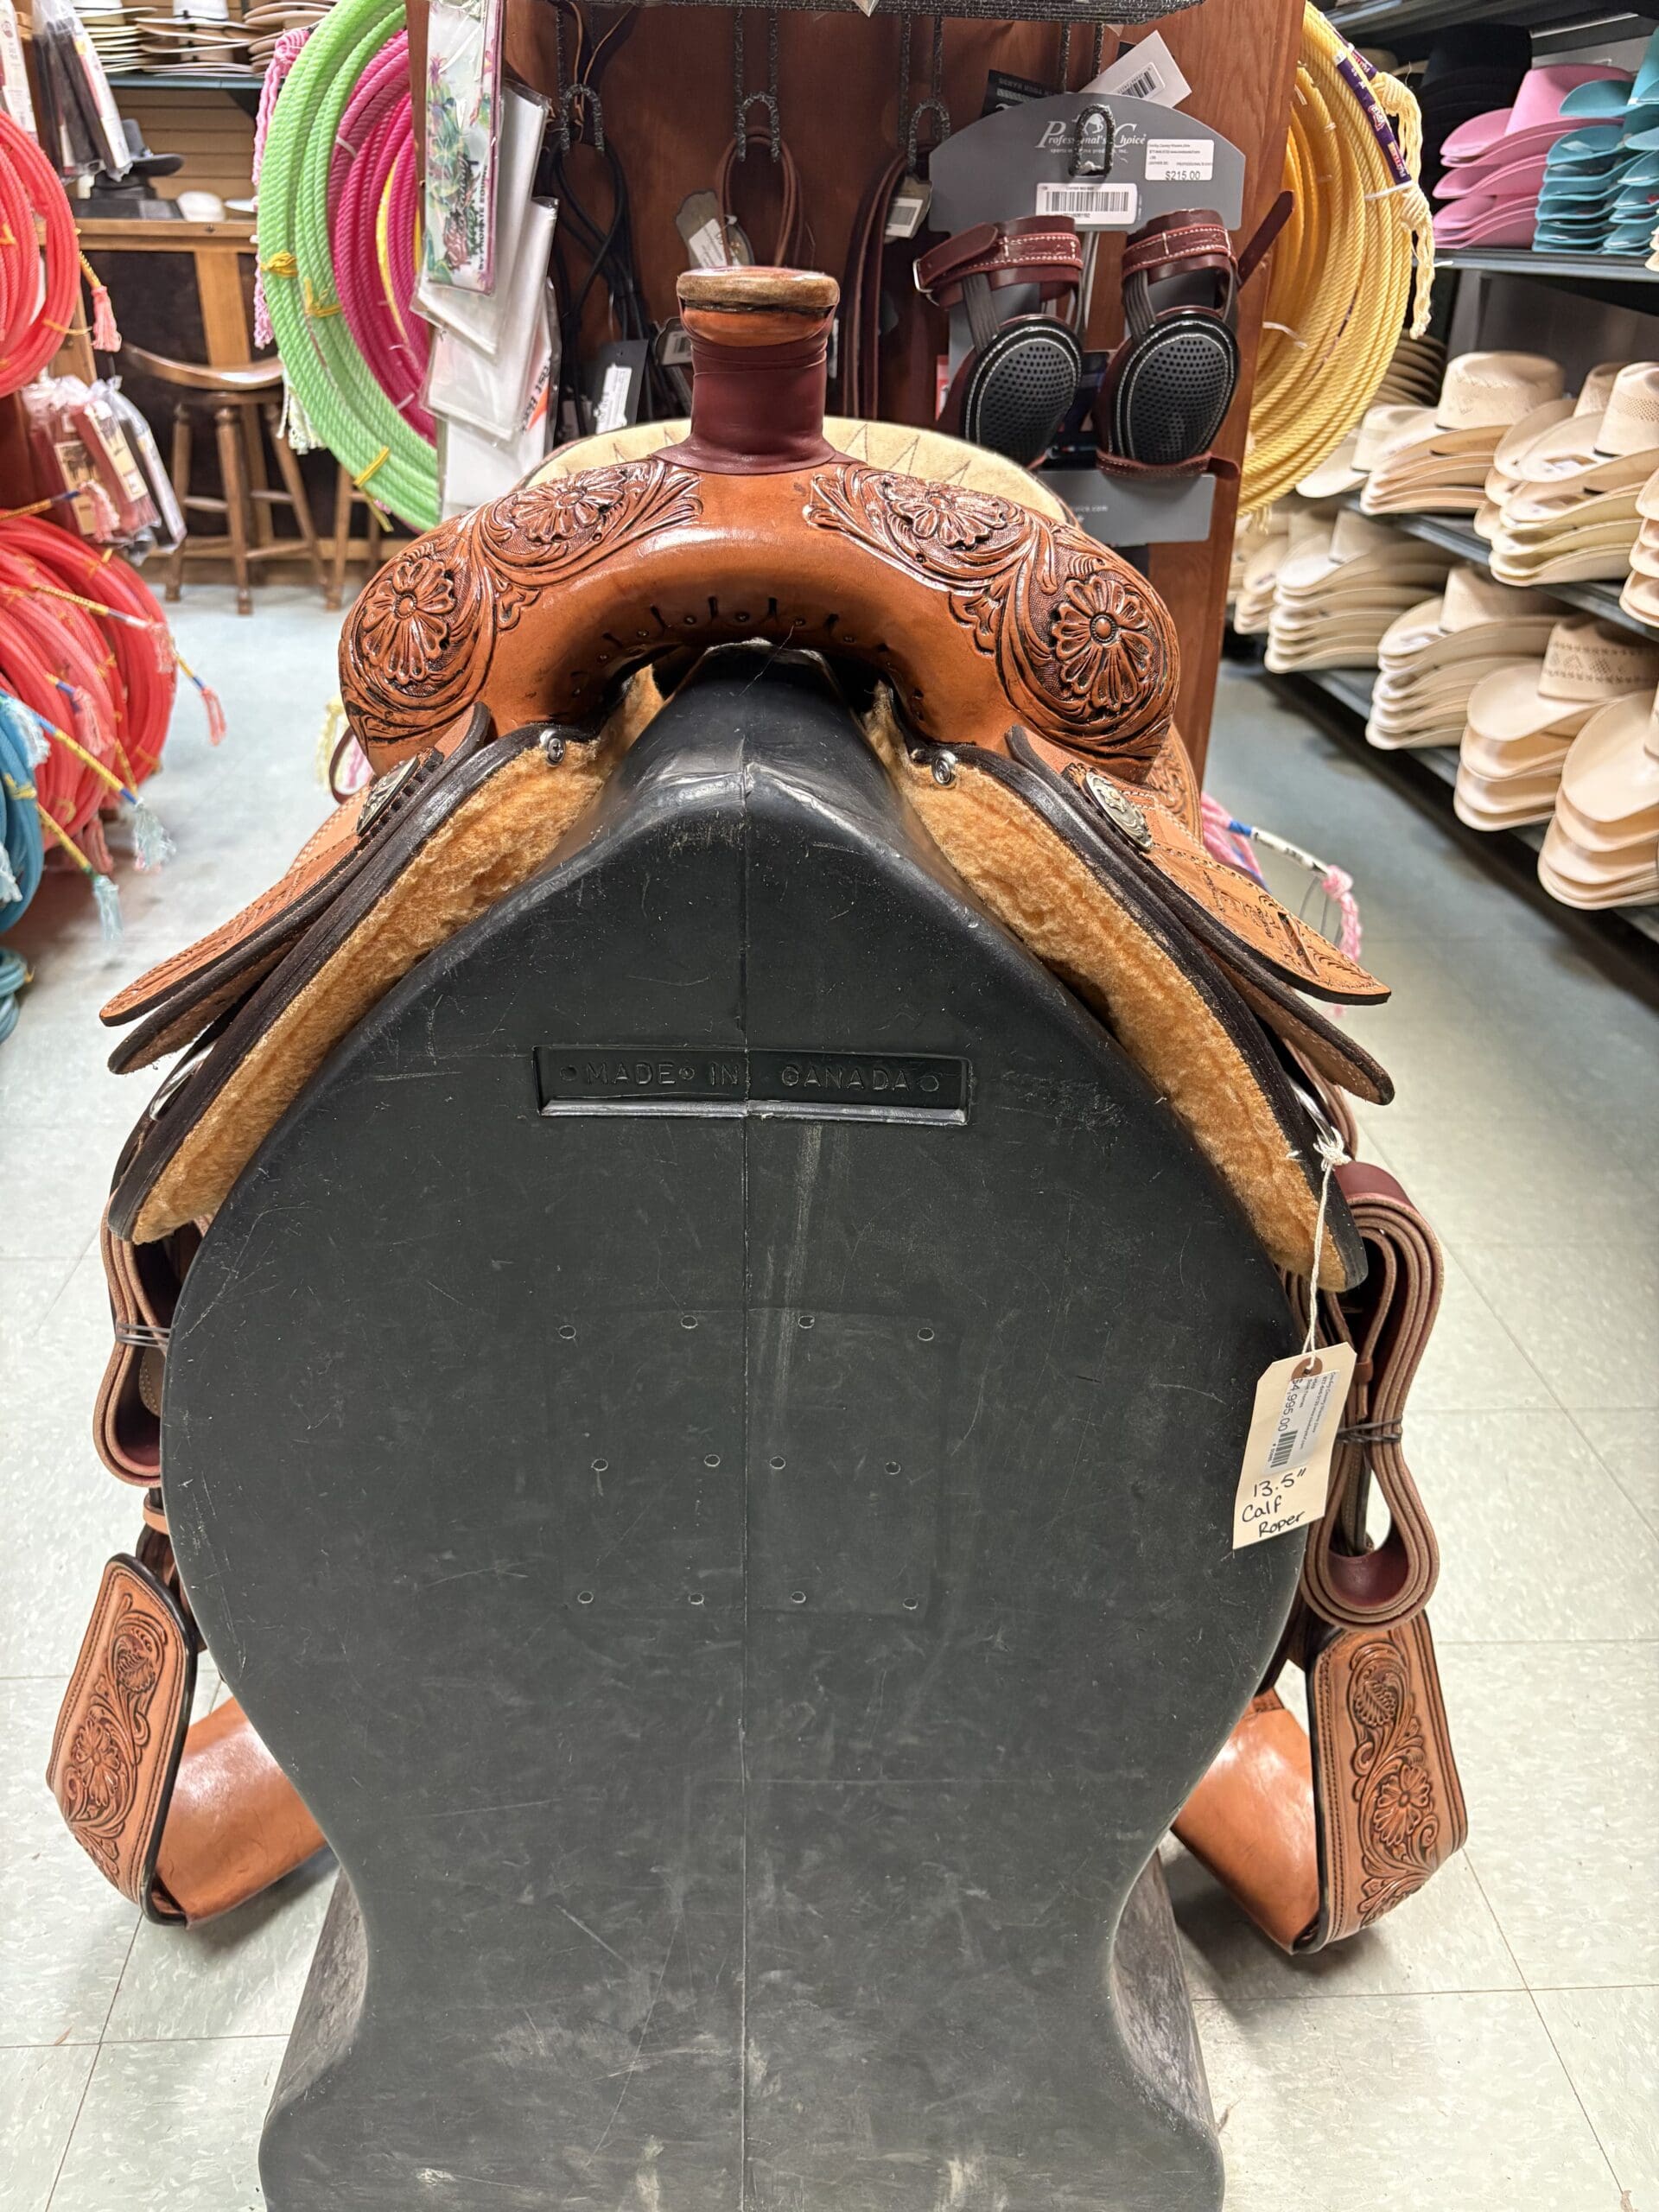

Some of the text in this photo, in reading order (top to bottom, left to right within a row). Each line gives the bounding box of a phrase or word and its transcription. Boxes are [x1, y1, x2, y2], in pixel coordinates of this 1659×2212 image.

[1034, 121, 1107, 148] Professonal's
[1165, 170, 1201, 181] $215.00
[587, 1060, 912, 1091] MADE IN CANADA
[1277, 1378, 1302, 1432] $4,995.00
[1242, 1495, 1283, 1522] Calf
[1258, 1511, 1305, 1538] Roper
